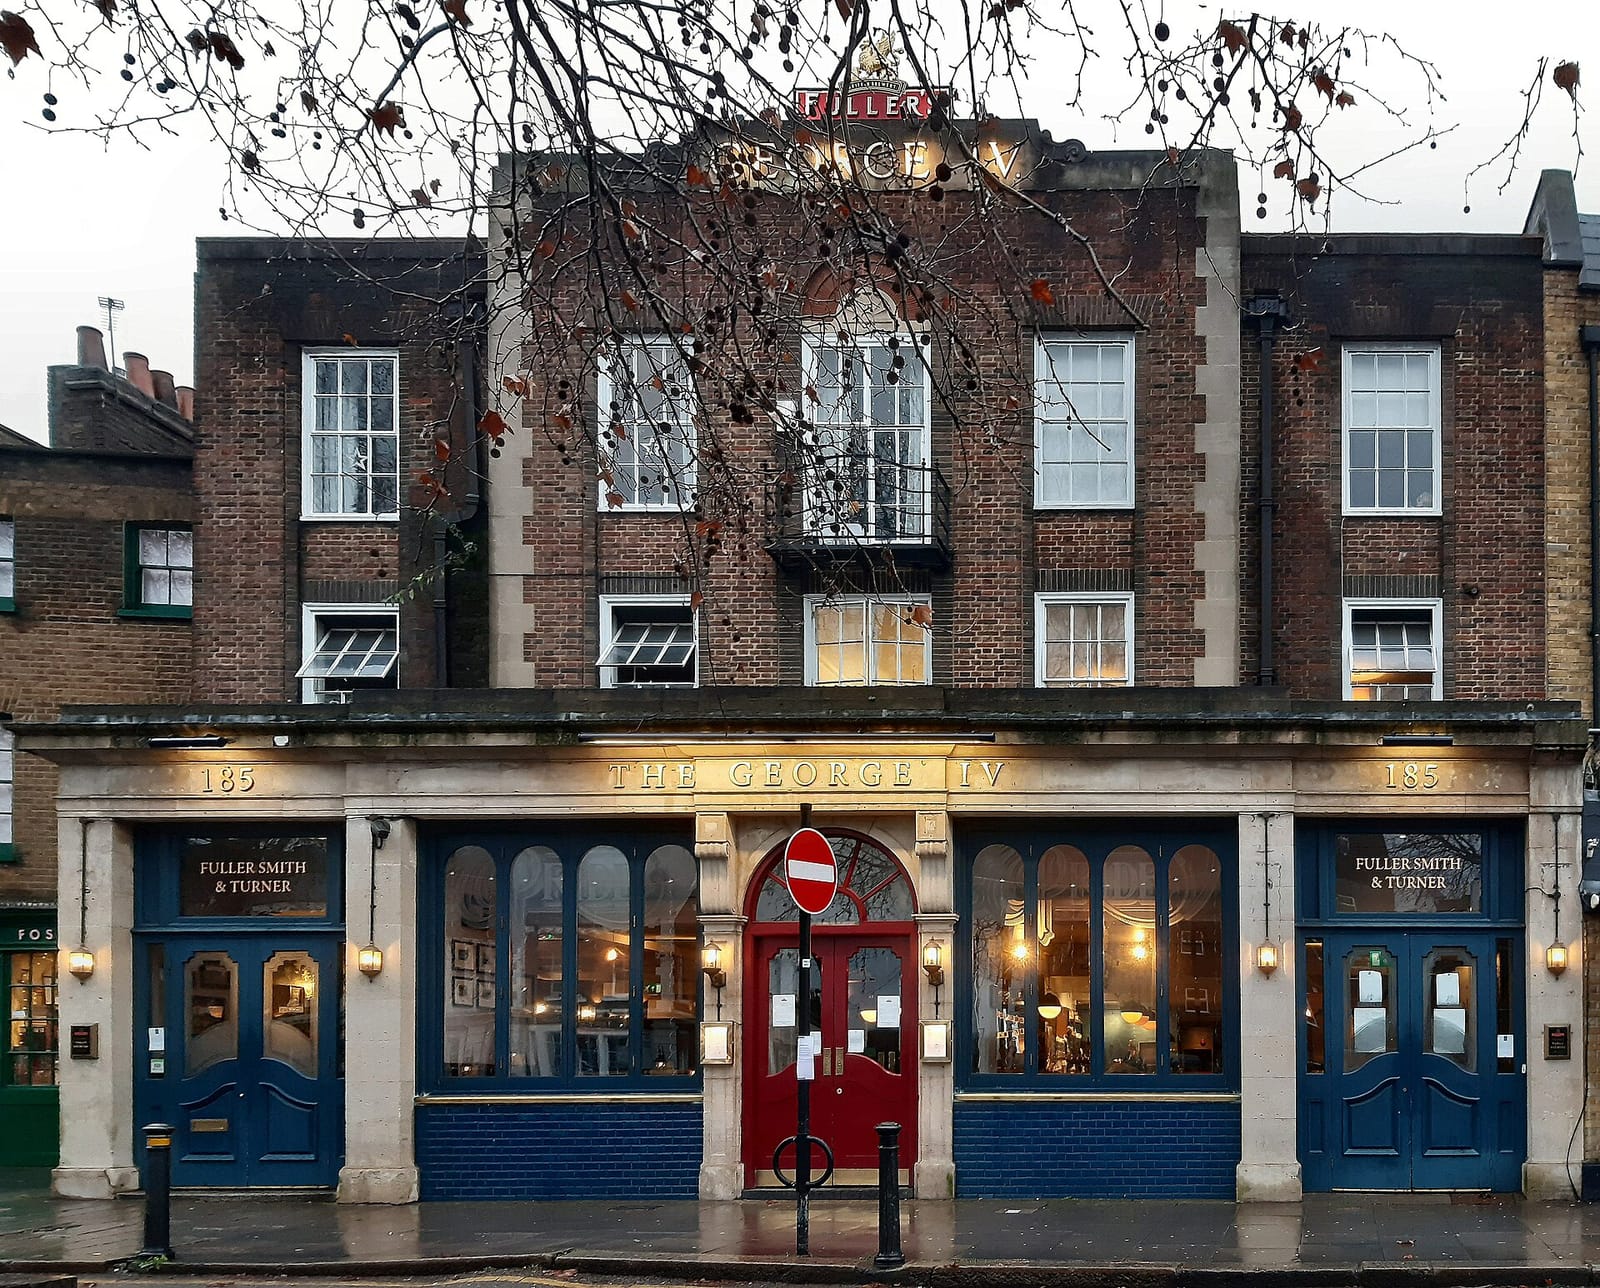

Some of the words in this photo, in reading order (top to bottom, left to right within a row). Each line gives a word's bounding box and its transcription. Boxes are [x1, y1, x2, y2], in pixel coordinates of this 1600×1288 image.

[201, 767, 255, 793] 185
[609, 763, 697, 789] THE
[728, 761, 912, 787] GEORGE
[959, 760, 1005, 787] IV
[1385, 763, 1440, 789] 185
[200, 861, 256, 875] FULLER
[258, 861, 307, 875] SMITH
[1356, 857, 1411, 870] FULLER
[1413, 857, 1461, 870] SMITH
[215, 880, 227, 893] &
[230, 880, 292, 893] TURNER
[1371, 876, 1383, 889] &
[1385, 876, 1447, 889] TURNER
[18, 928, 54, 941] FOS
